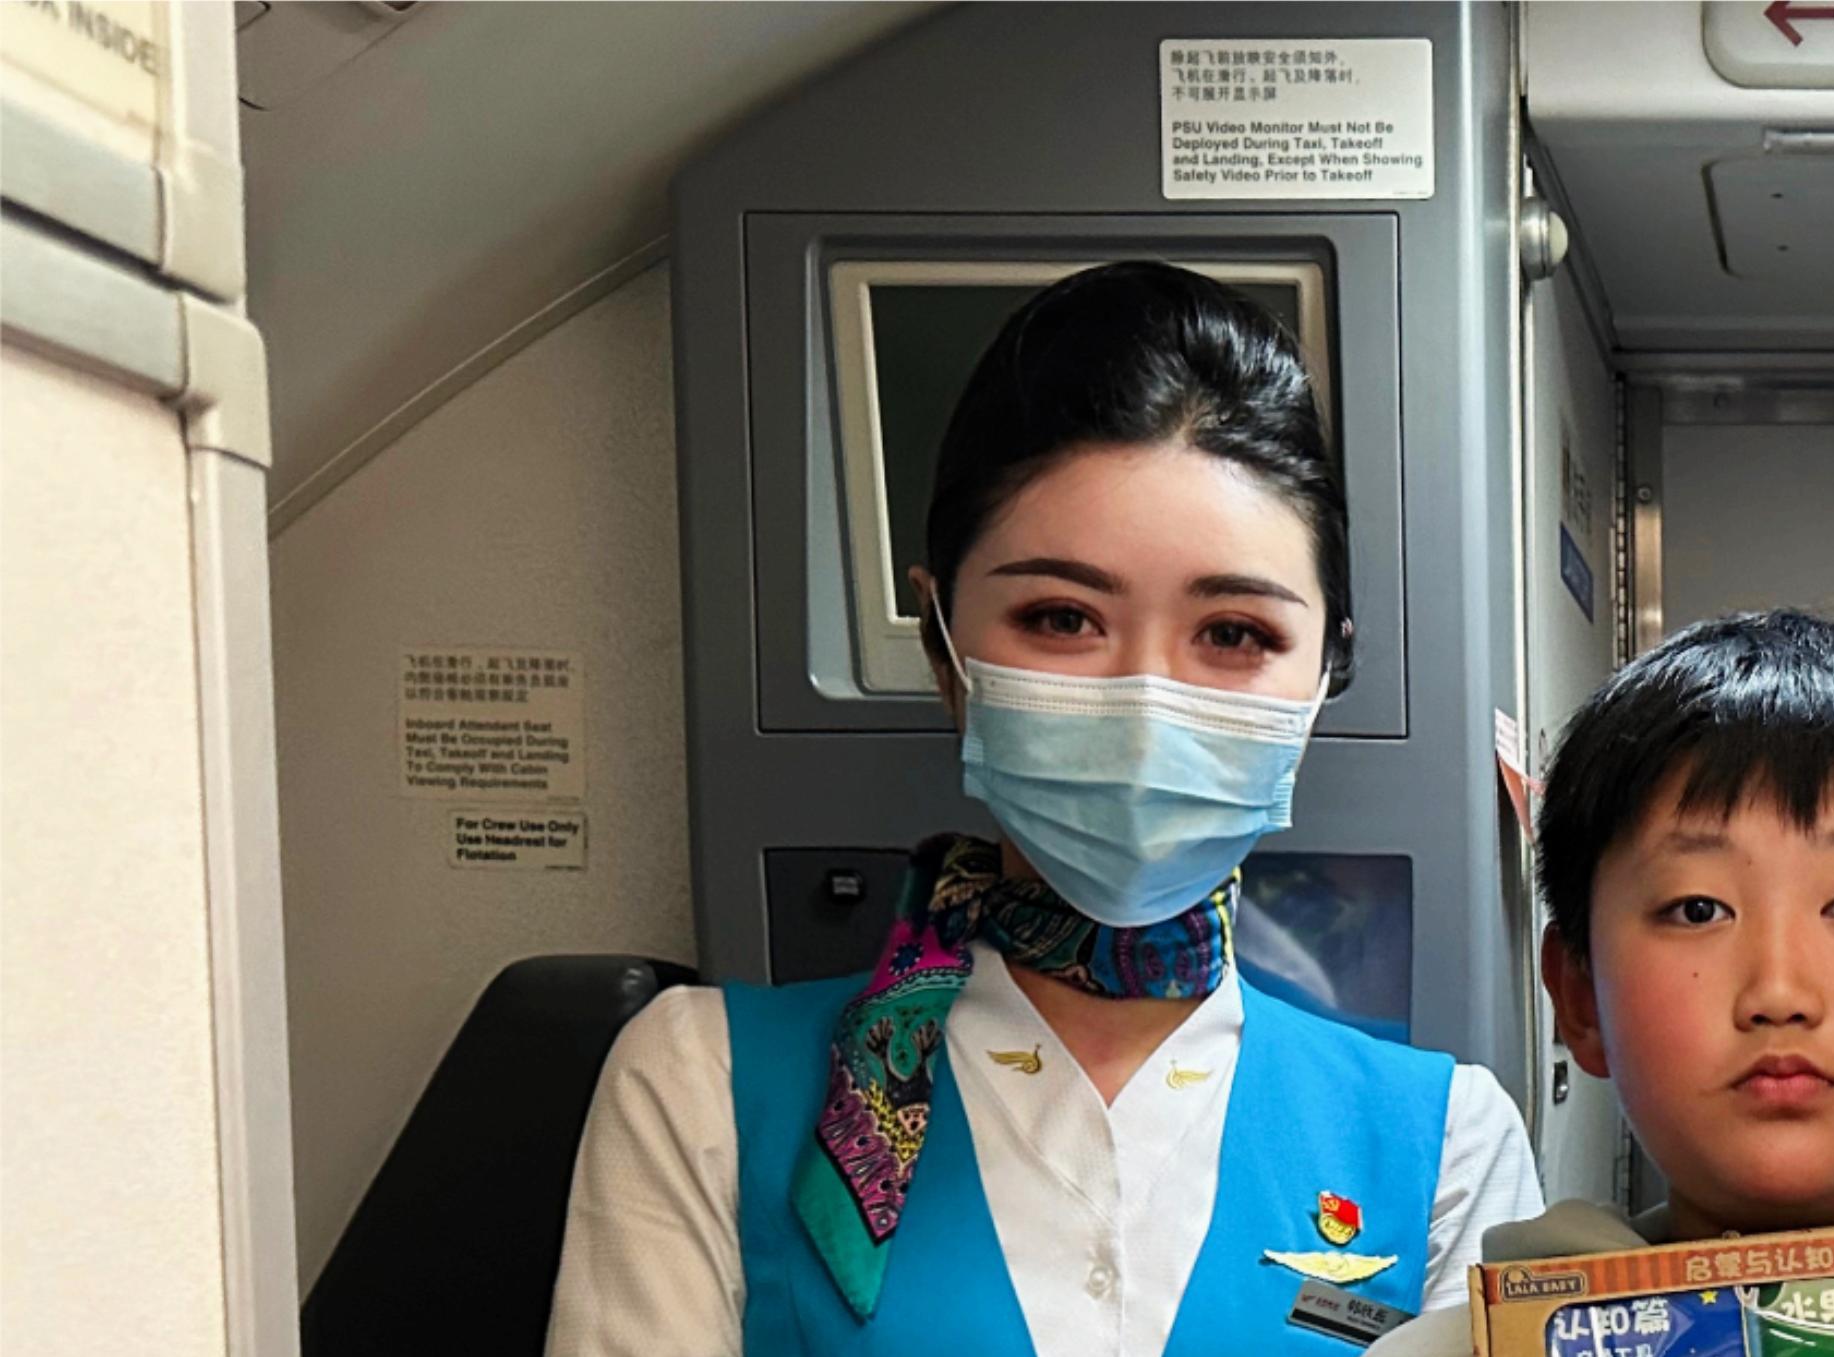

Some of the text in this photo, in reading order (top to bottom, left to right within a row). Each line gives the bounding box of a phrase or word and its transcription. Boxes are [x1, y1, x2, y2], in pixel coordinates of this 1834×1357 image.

[1172, 121, 1394, 134] PSU Video Monitor Must Not Be
[1172, 137, 1238, 151] Deployed
[1244, 137, 1288, 152] During
[1331, 137, 1383, 149] Takeoff
[1173, 154, 1199, 165] and
[1268, 153, 1315, 167] Except
[1319, 153, 1359, 165] When
[1362, 153, 1423, 168] Showing
[1173, 169, 1373, 184] Safety Video Prior to Takeoff
[456, 817, 579, 835] For Crew Use Only
[456, 833, 567, 847] Use Headrest for
[1505, 1278, 1578, 1296] LALA BABY
